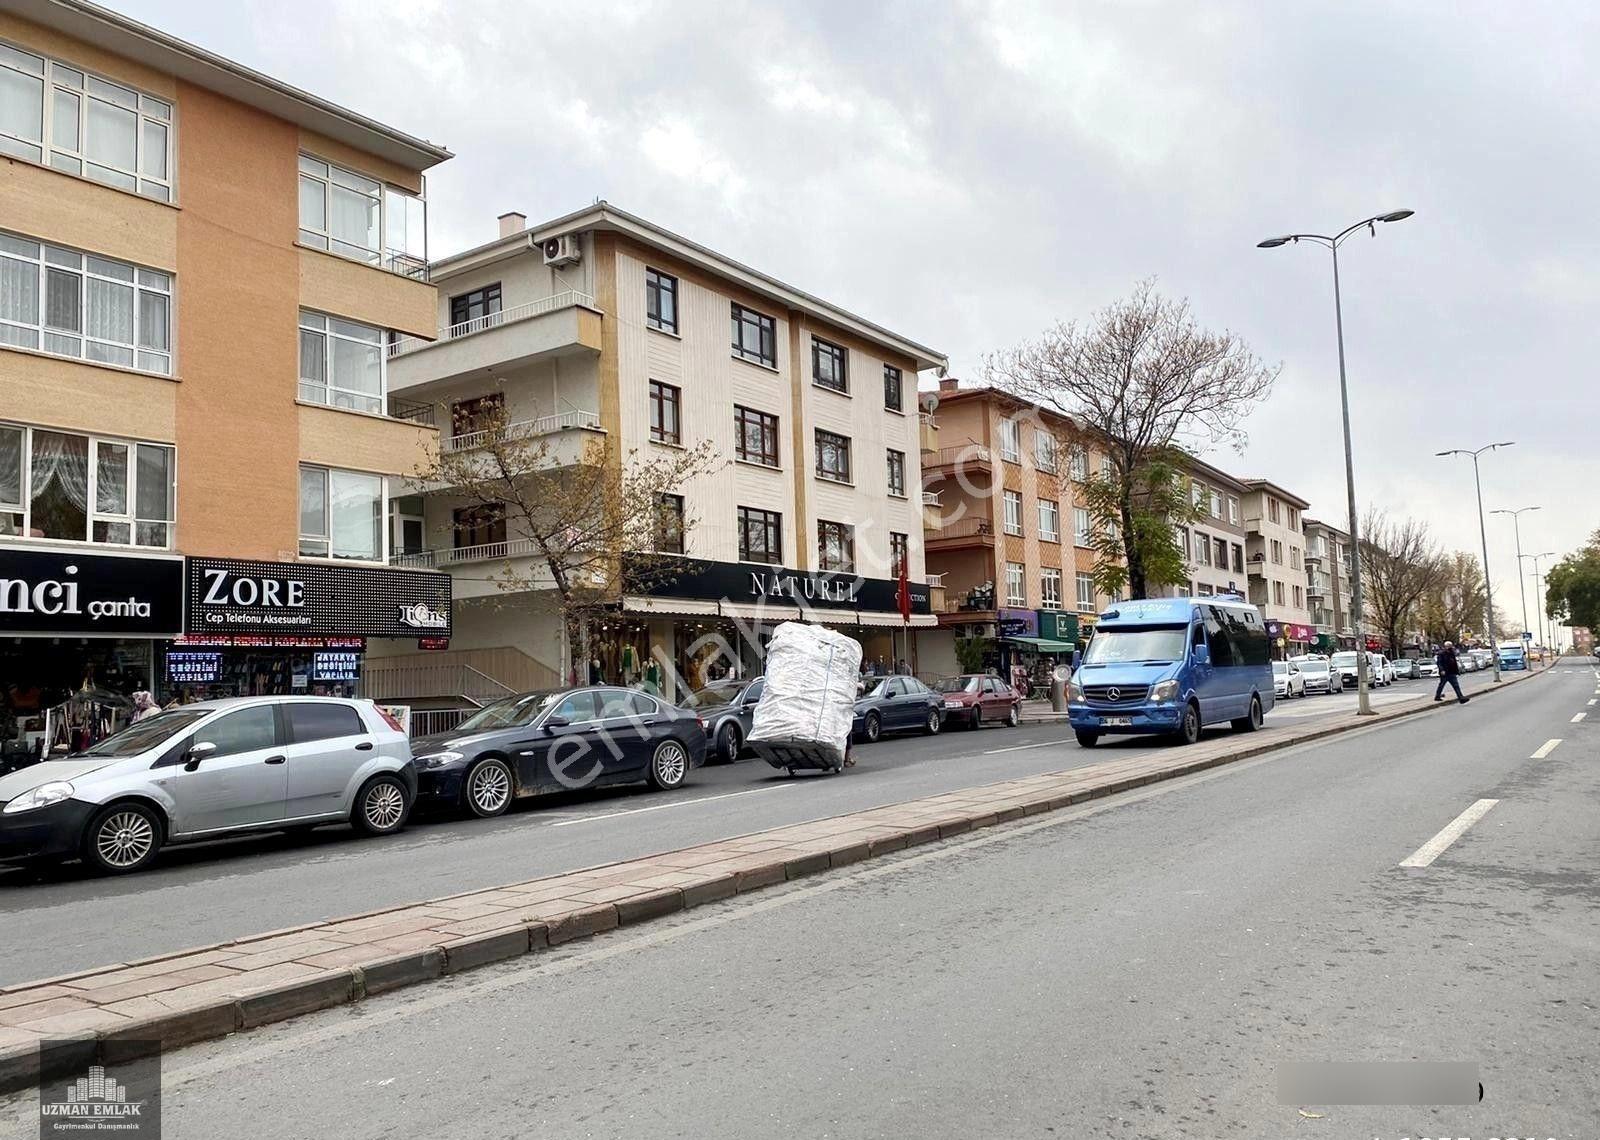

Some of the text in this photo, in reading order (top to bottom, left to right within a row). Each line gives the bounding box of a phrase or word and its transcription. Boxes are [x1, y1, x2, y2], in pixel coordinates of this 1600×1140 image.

[0, 565, 151, 620] nci çanta
[203, 569, 305, 607] ZORE
[750, 572, 858, 603] NATUREL
[205, 612, 311, 625] Cep Telefonu Aksesuarları
